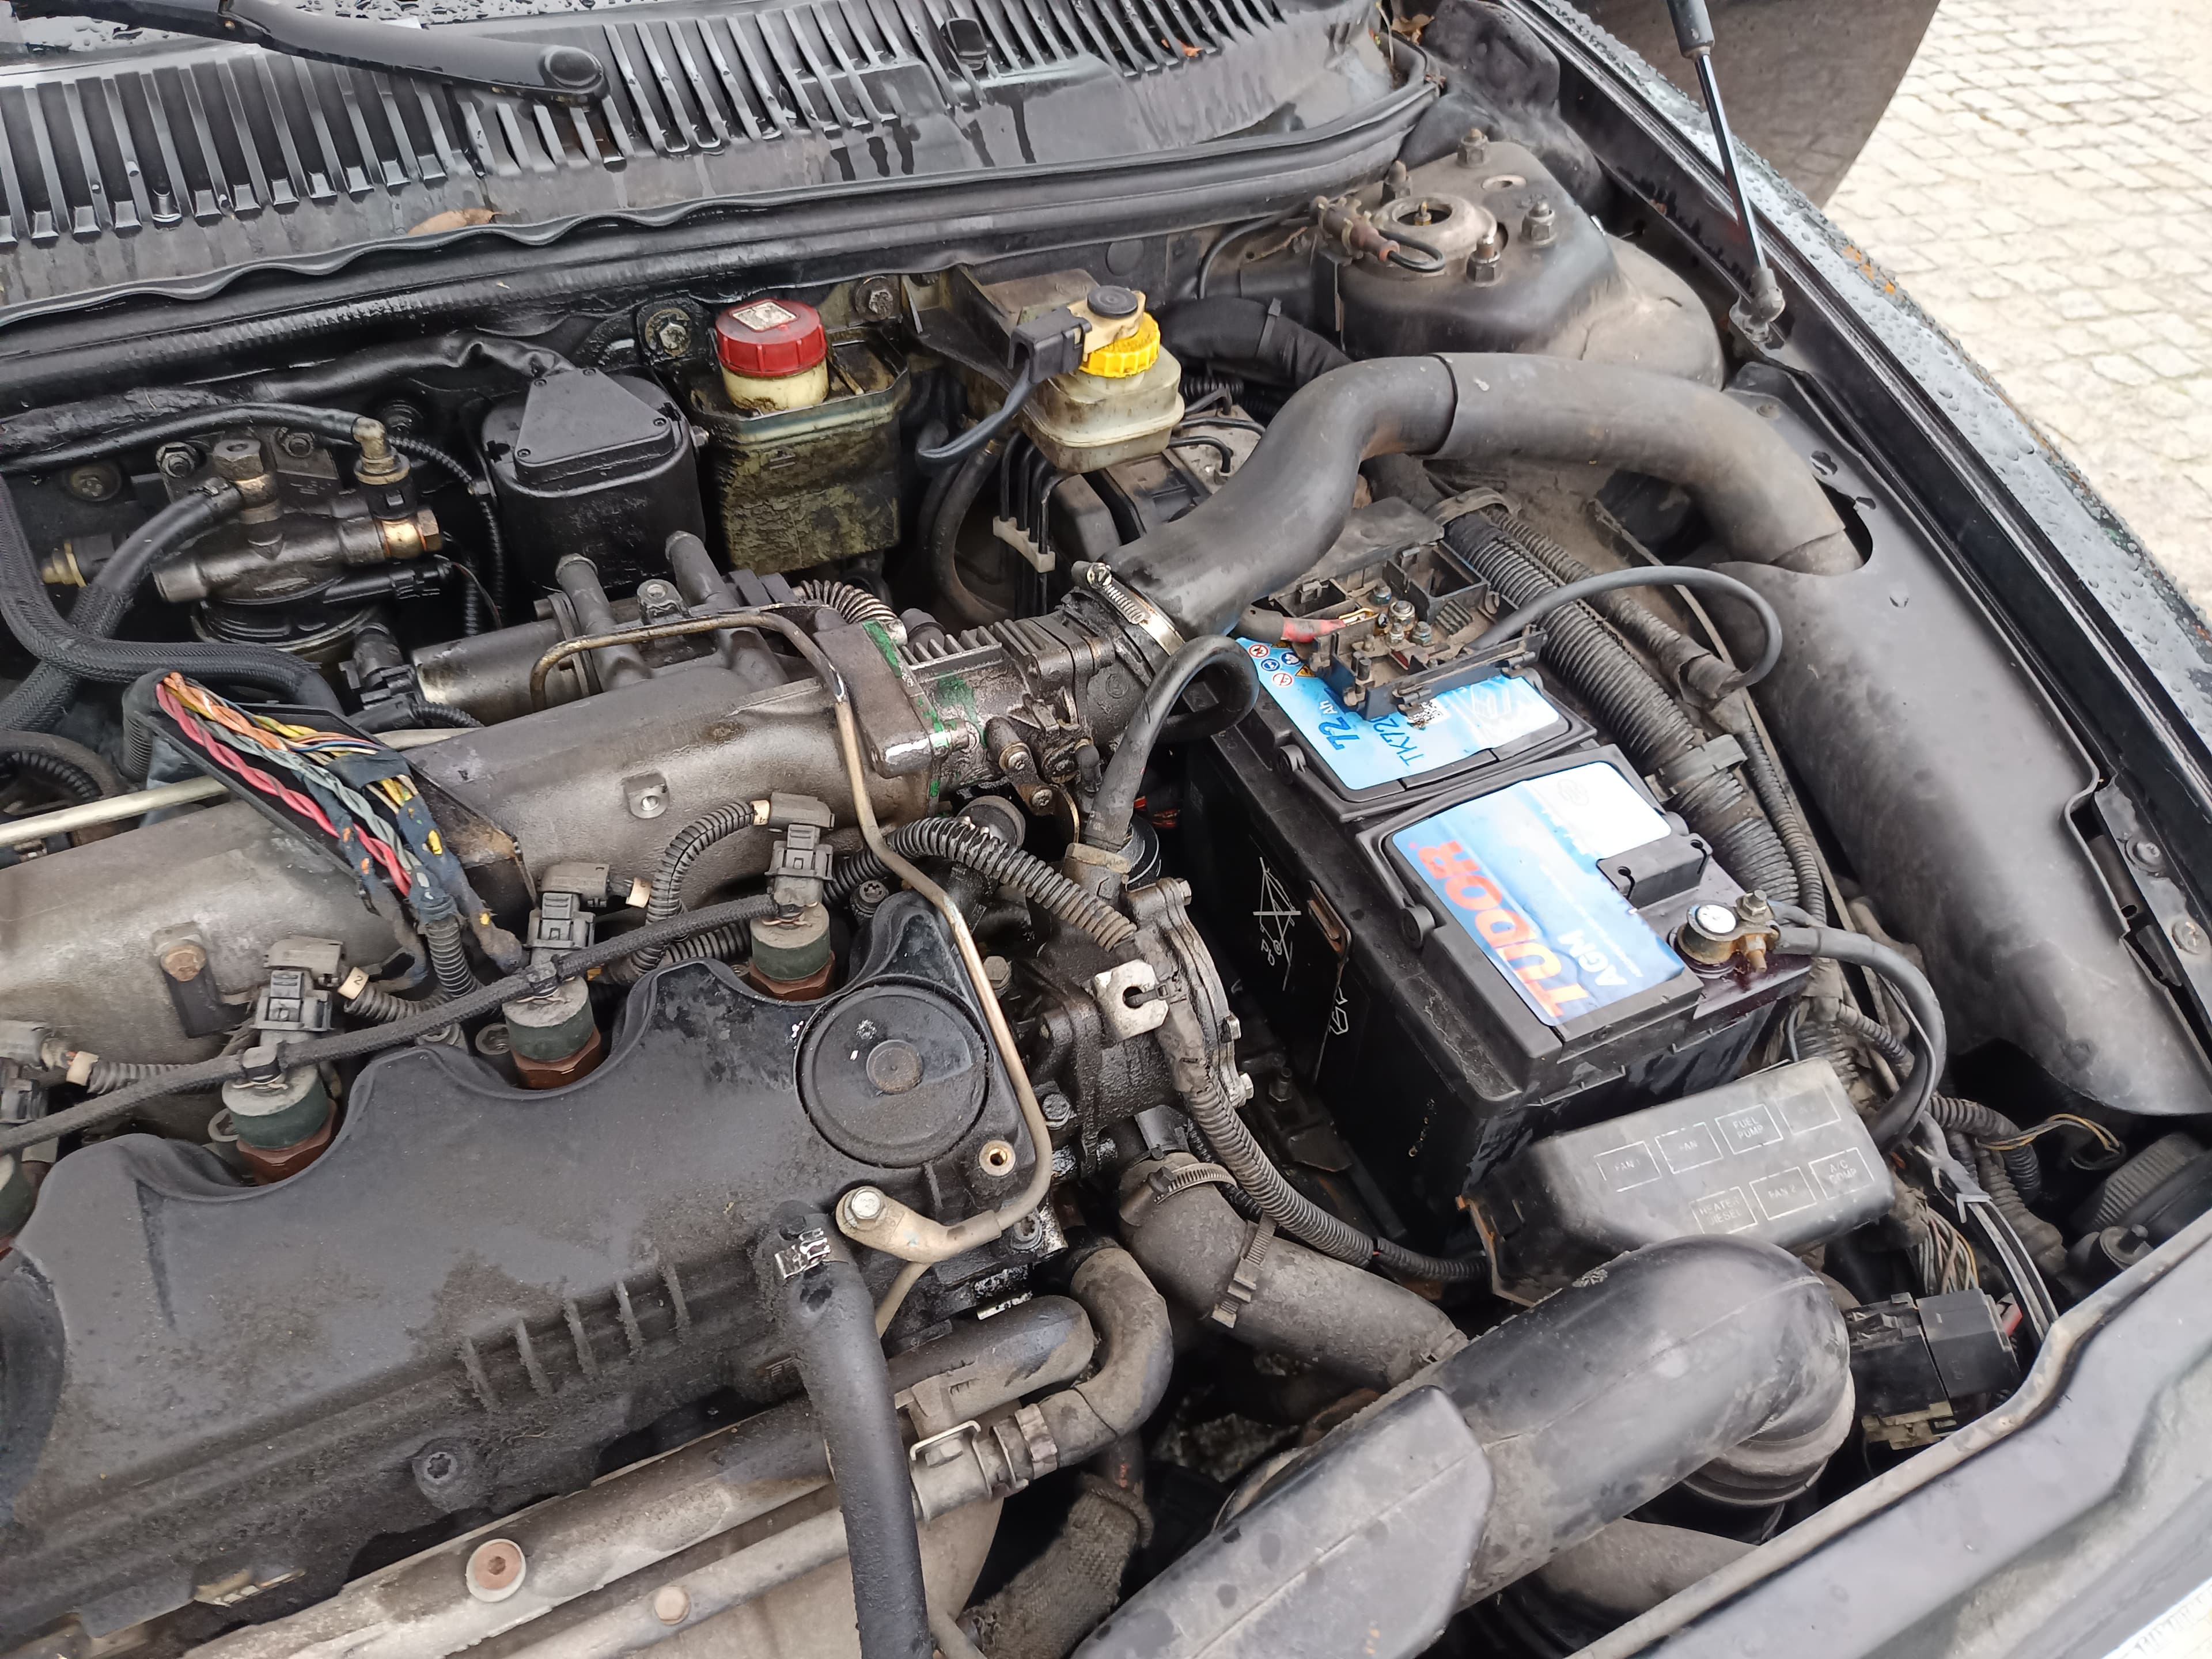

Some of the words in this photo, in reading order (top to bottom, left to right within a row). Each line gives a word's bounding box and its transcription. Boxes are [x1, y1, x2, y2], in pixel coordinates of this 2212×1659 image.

[1319, 699, 1339, 715] Ah
[1318, 716, 1360, 751] 72
[1369, 715, 1425, 767] TK72
[1417, 839, 1589, 1018] TUDOR
[1557, 929, 1628, 986] AGM
[353, 975, 363, 986] 2
[1732, 1116, 1759, 1129] FUEL
[1737, 1124, 1764, 1139] PUMP
[1829, 1159, 1849, 1173] A/C
[1829, 1168, 1857, 1184] COMP
[1767, 1187, 1789, 1199] FAN
[1790, 1184, 1797, 1194] 2
